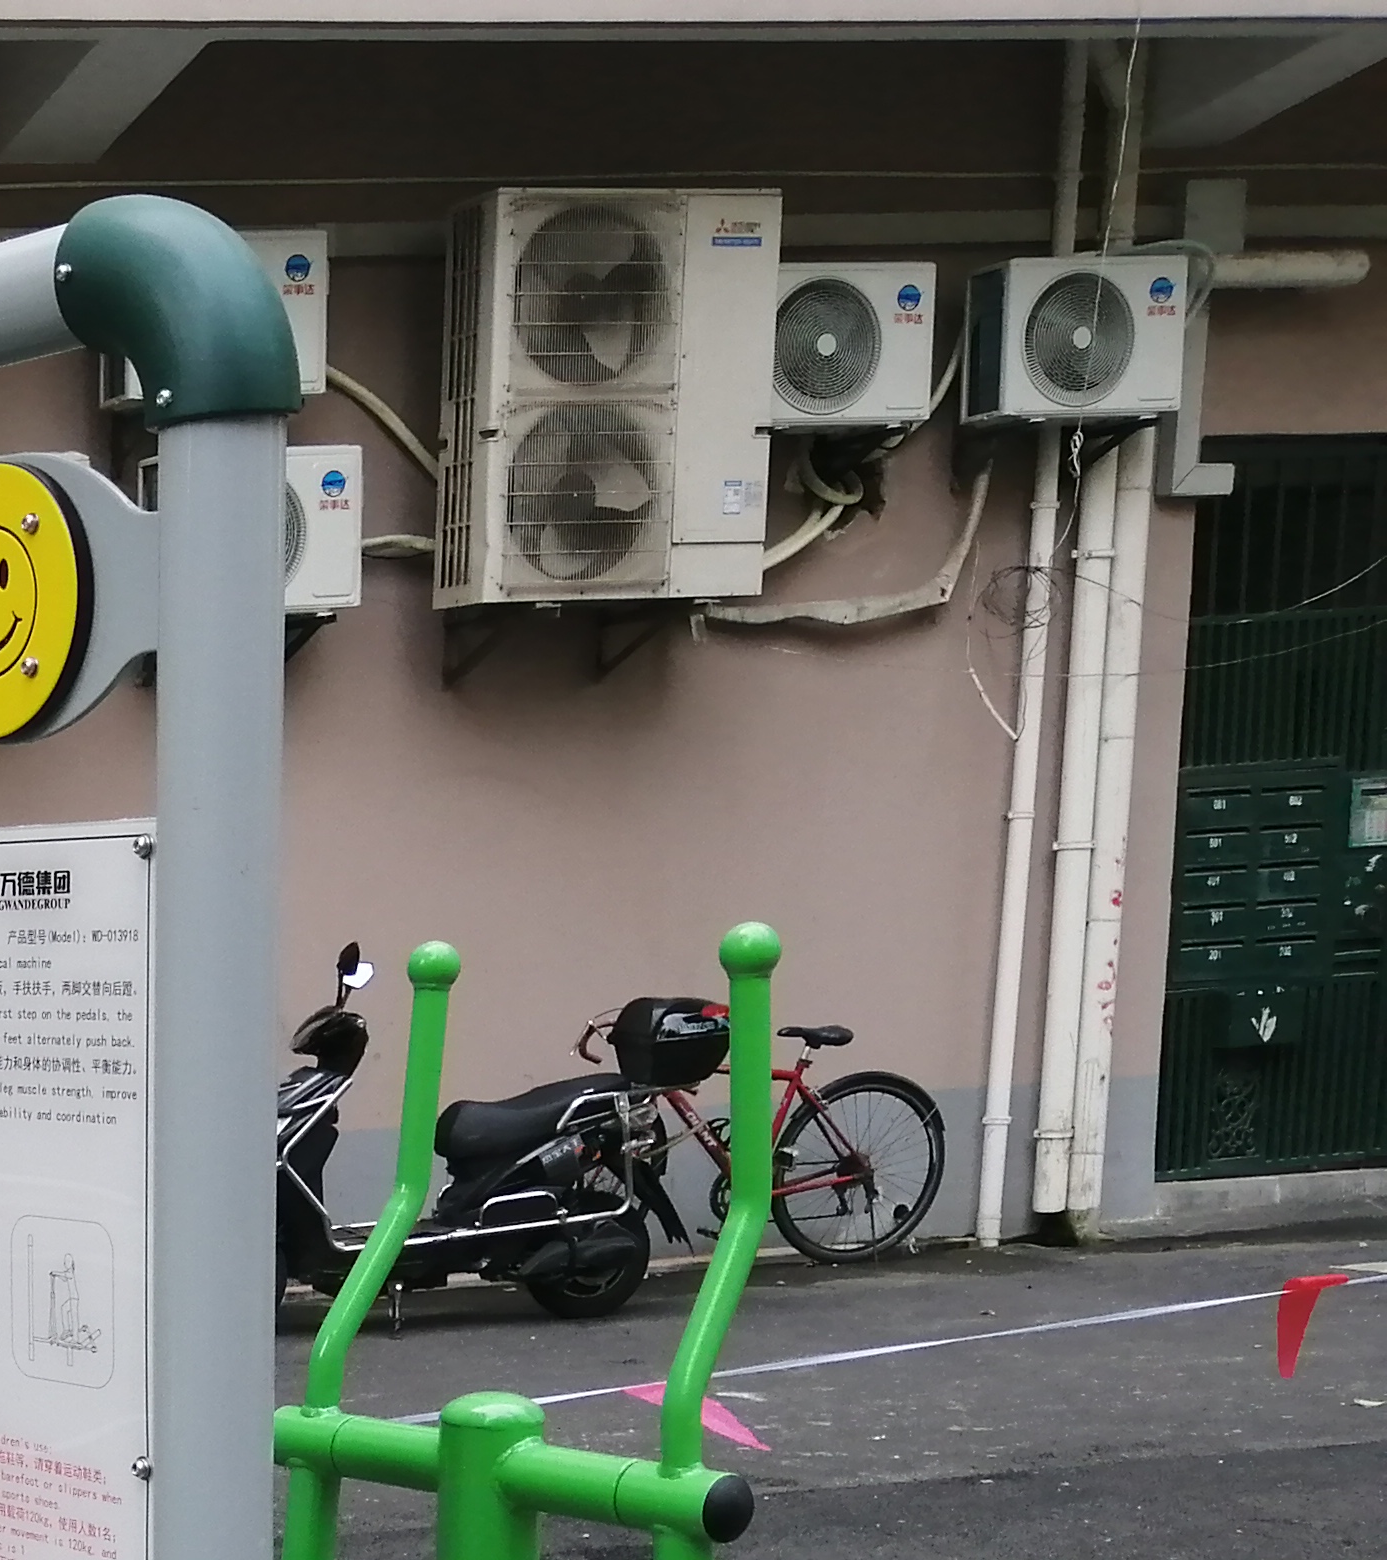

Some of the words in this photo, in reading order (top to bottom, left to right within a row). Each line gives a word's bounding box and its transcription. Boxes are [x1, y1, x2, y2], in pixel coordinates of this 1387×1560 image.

[16, 956, 52, 969] machine
[17, 1009, 37, 1020] step
[41, 1010, 52, 1020] on
[57, 1008, 71, 1020] the
[117, 1009, 133, 1021] the
[3, 1032, 22, 1044] feet
[27, 1032, 81, 1048] alternately
[86, 1034, 107, 1048] push
[0, 1082, 13, 1096] leg
[17, 1083, 46, 1095] muscle
[102, 1086, 138, 1100] improve
[36, 1108, 52, 1121] and
[56, 1111, 117, 1125] coordination
[1, 1469, 39, 1487] barefoot
[43, 1481, 53, 1490] or
[58, 1483, 97, 1500] slippers
[102, 1492, 122, 1505] when
[1, 1490, 30, 1504] sports
[7, 1544, 16, 1554] is
[10, 1527, 49, 1544] movement
[54, 1537, 64, 1547] is
[101, 1549, 117, 1560] and
